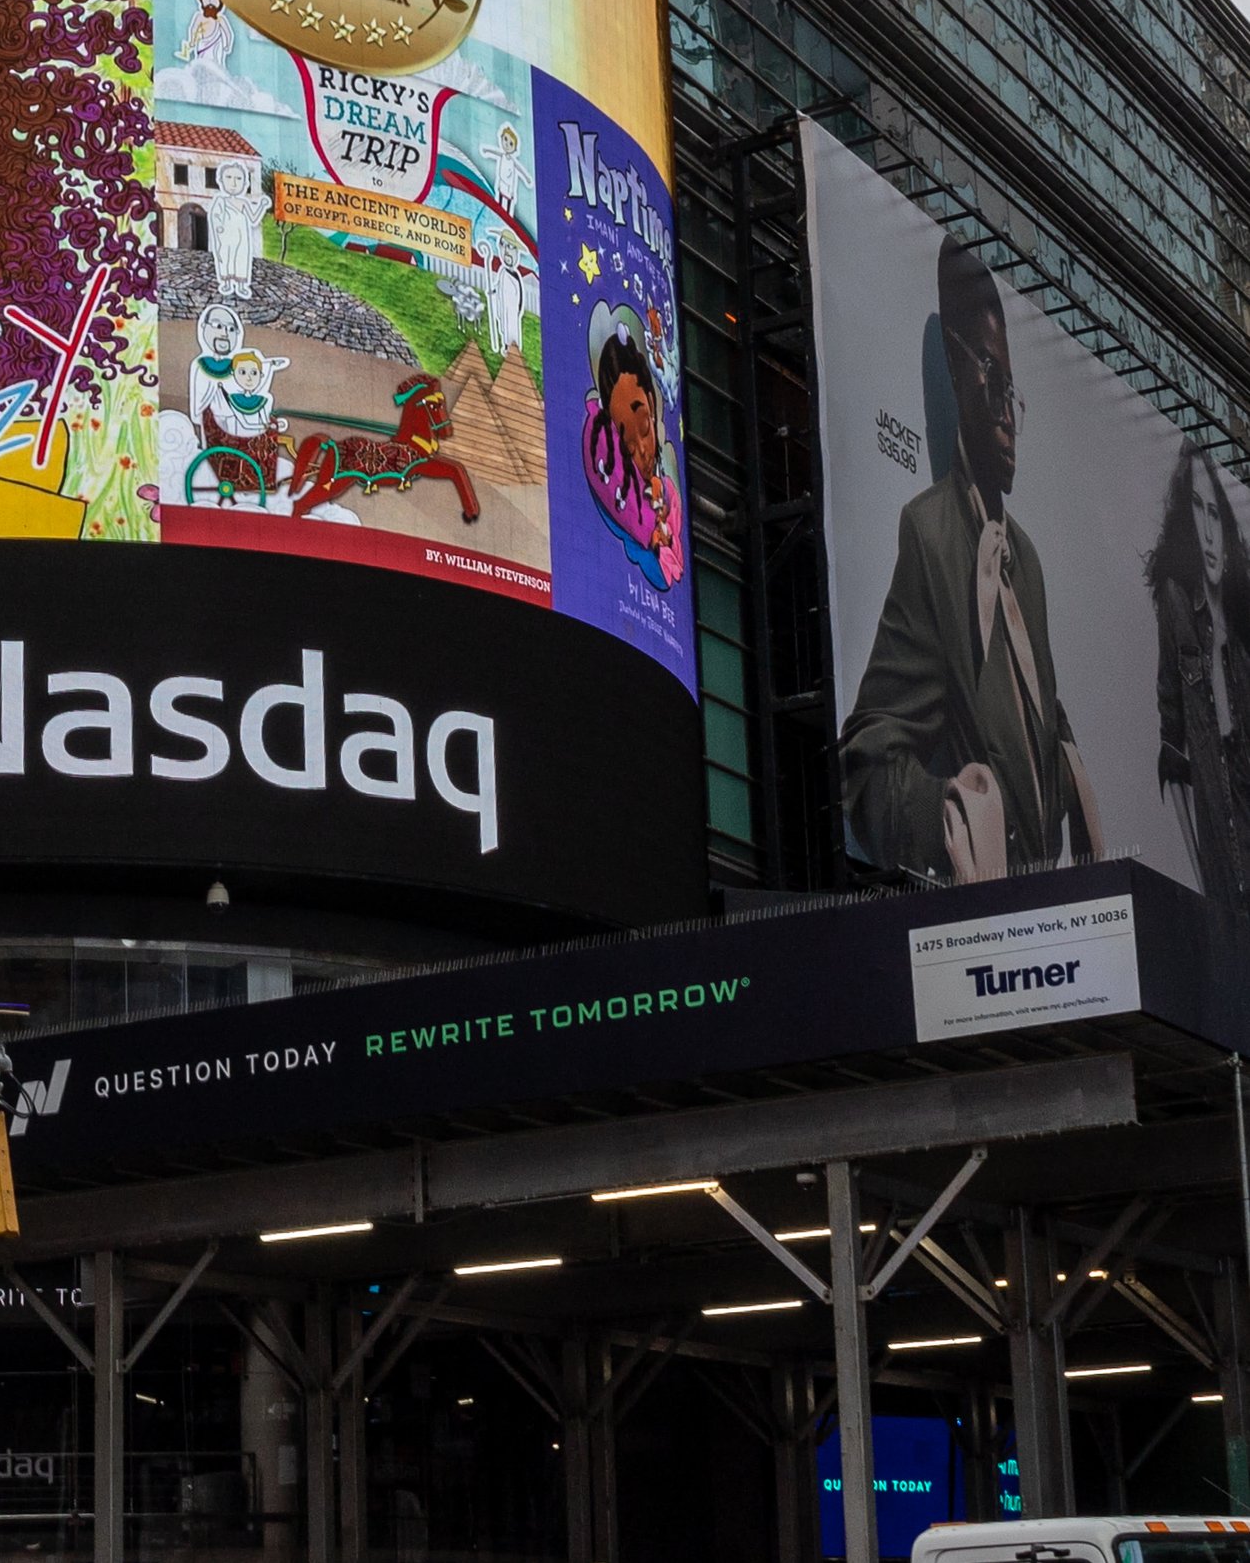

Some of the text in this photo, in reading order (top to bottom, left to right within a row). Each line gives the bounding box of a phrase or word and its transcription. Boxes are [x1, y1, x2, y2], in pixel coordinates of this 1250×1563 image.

[318, 66, 431, 114] RICKY'S
[323, 95, 427, 145] DREAM
[340, 129, 421, 173] TRIP
[372, 176, 383, 188] to
[283, 182, 467, 240] THE ANCIENT WORLDS
[284, 202, 466, 257] OF EGYPT, GREECE, AND ROME
[875, 408, 922, 455] JACKET
[877, 431, 917, 475] $35.99
[425, 548, 552, 594] BY: WILLIAM STEVENSON
[915, 908, 1129, 954] 1475 Broadway New York, NY 10036
[965, 959, 1081, 998] Turner
[93, 1057, 232, 1100] QUESTION
[245, 1040, 338, 1075] TODAY
[365, 1012, 515, 1058] REWRITE
[892, 1479, 933, 1494] TODAY
